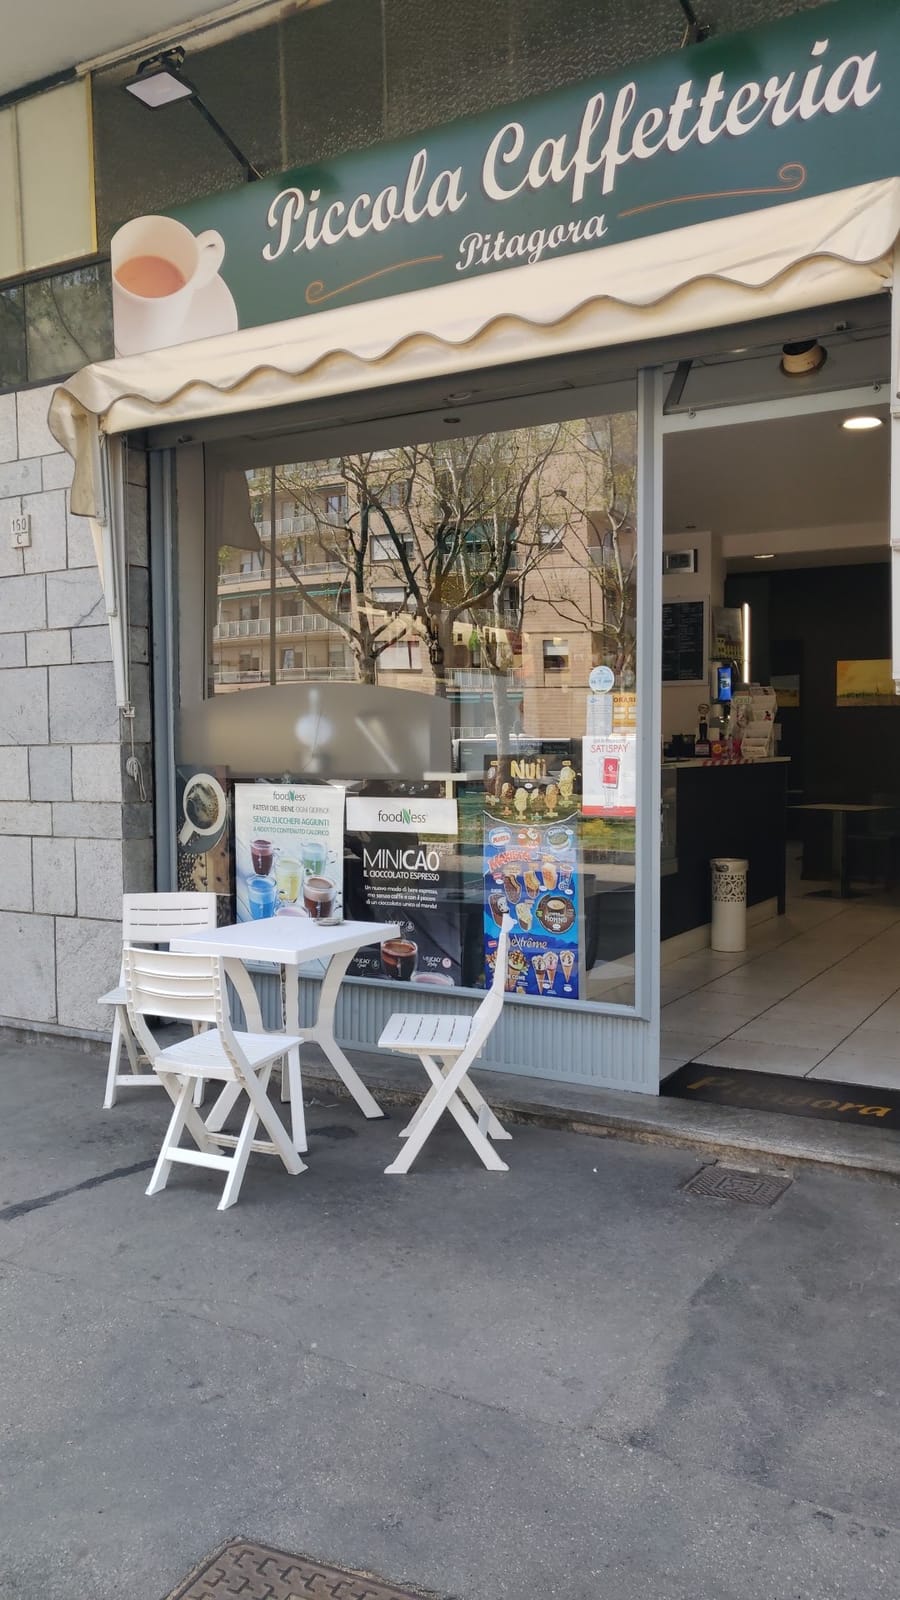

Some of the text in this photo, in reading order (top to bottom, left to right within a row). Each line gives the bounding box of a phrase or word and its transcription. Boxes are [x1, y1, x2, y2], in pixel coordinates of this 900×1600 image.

[262, 39, 882, 262] Piccola Caffetteria
[455, 212, 608, 271] Pitagora
[12, 518, 27, 532] 150
[16, 534, 23, 545] C
[591, 744, 628, 753] SATISPAY
[363, 870, 440, 881] IL CIOCCOLATO ESPRESSO
[687, 1076, 893, 1118] Pgora
